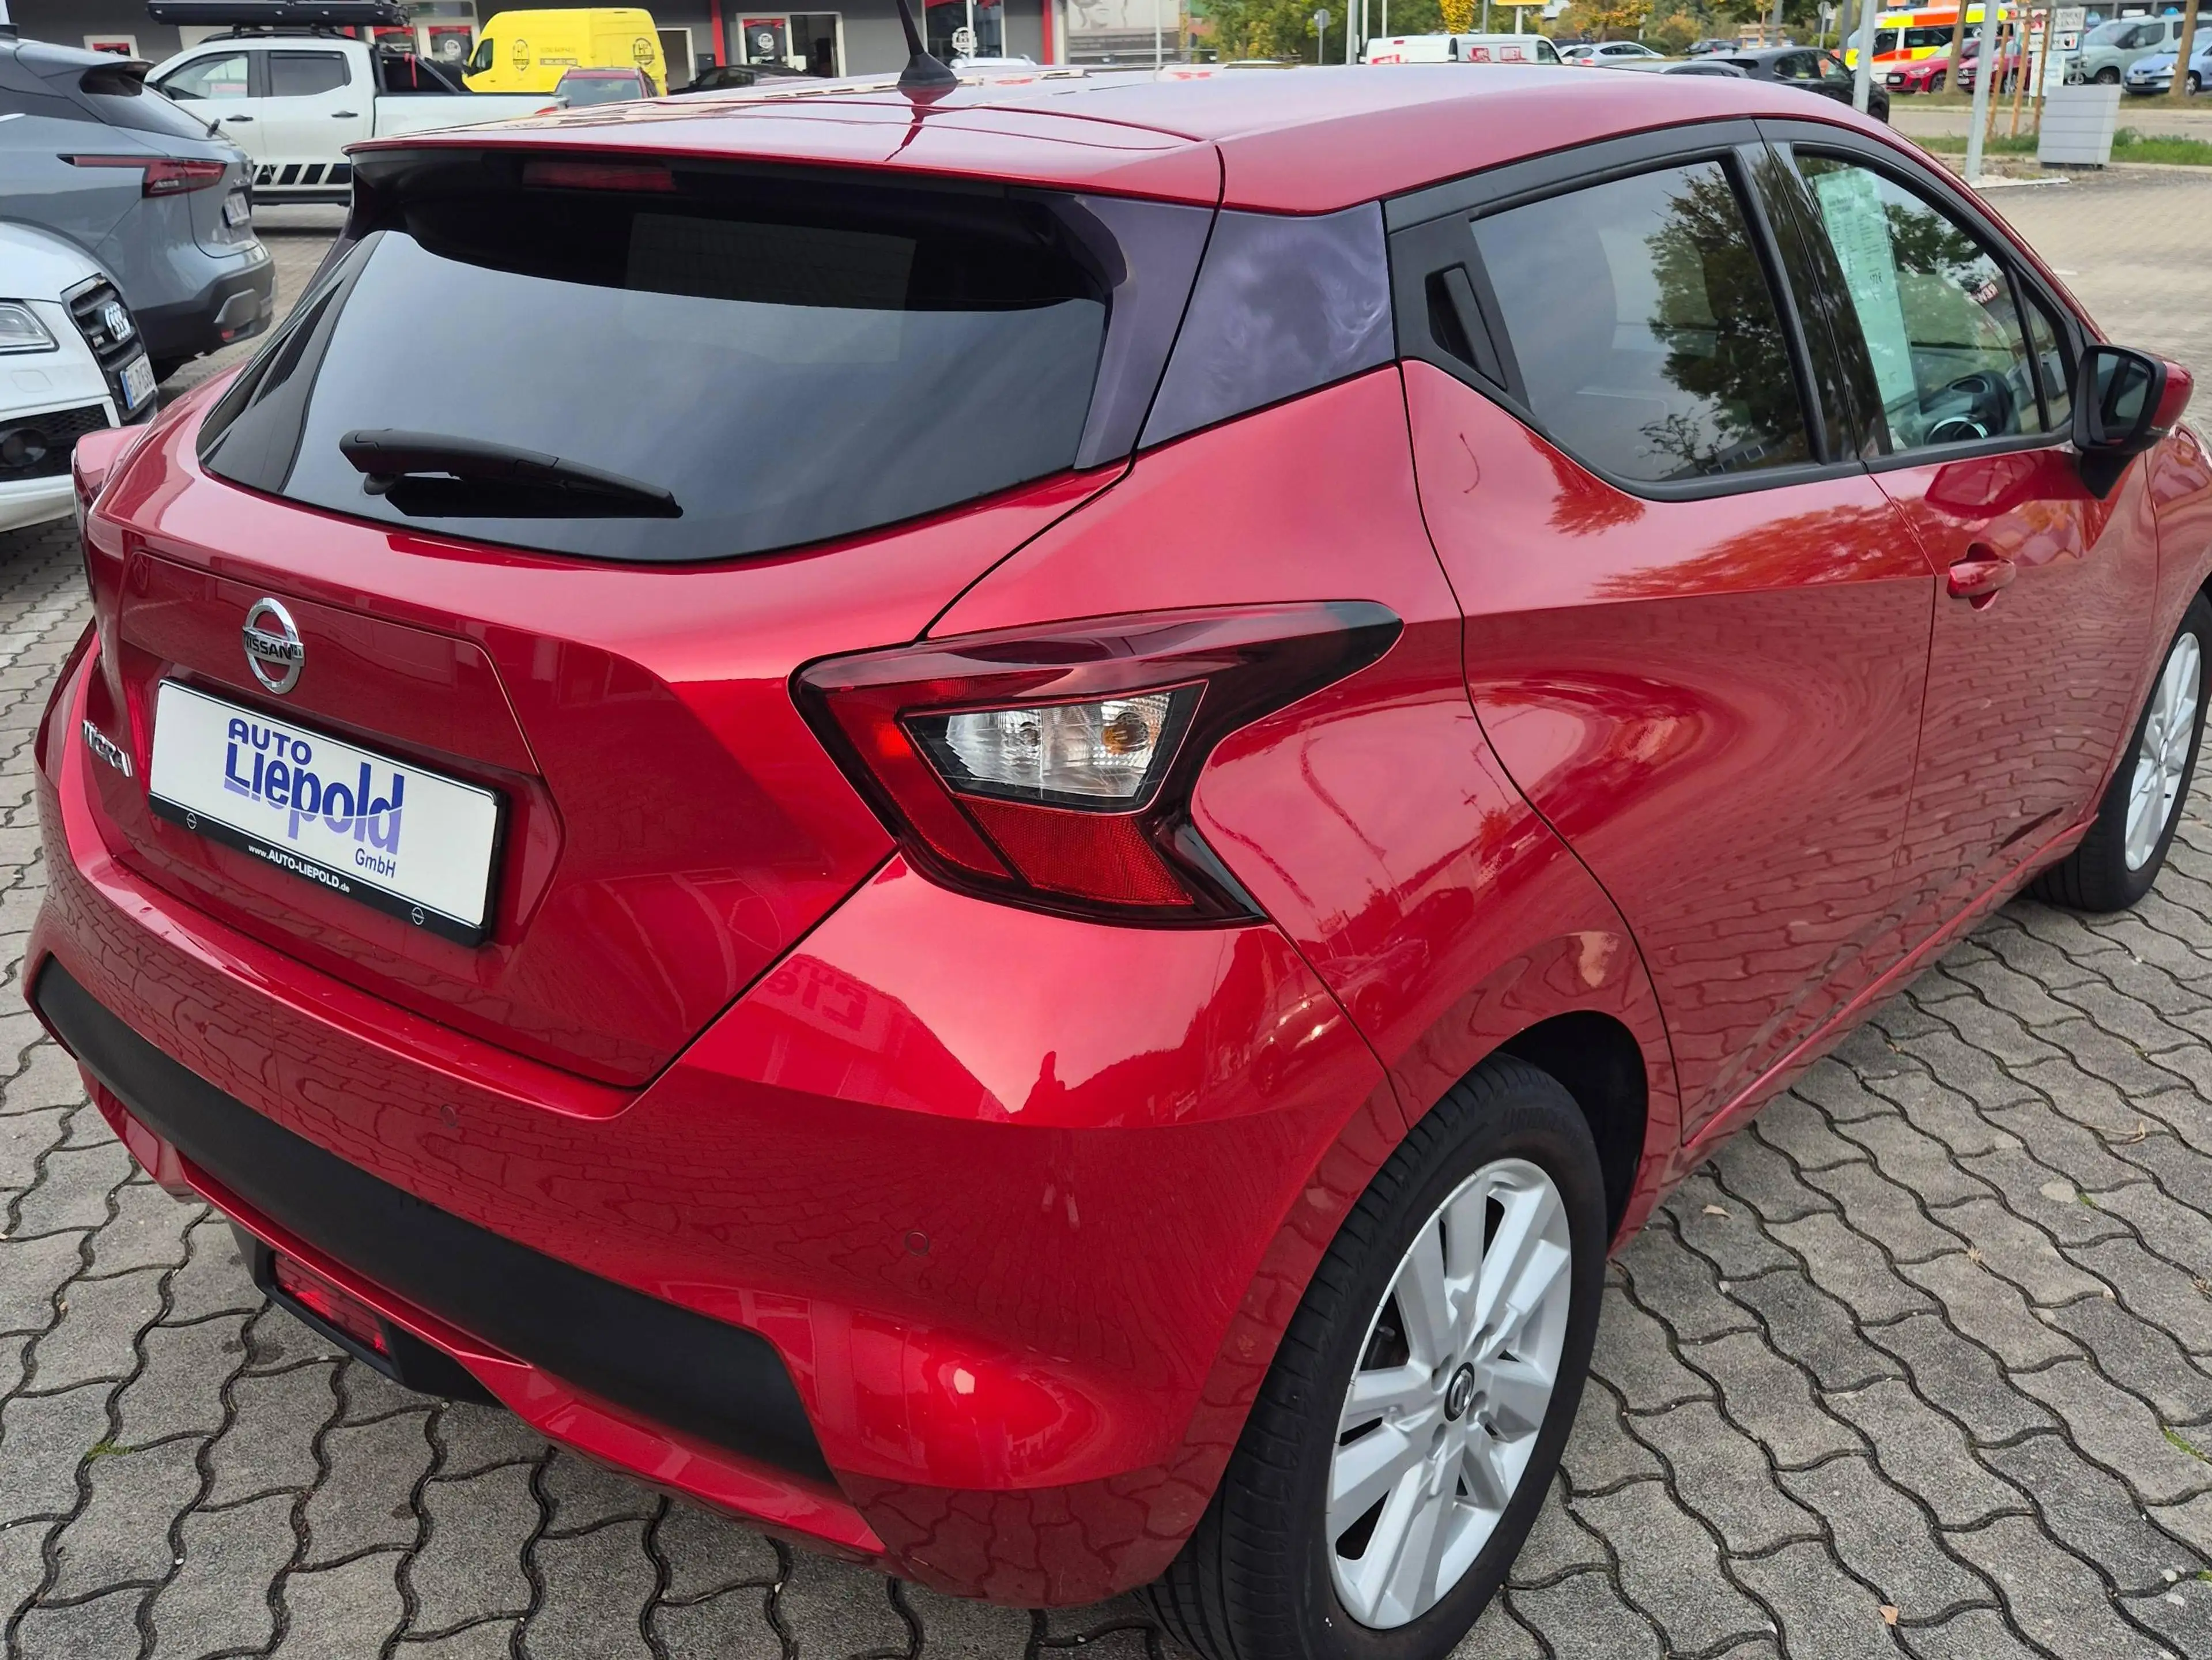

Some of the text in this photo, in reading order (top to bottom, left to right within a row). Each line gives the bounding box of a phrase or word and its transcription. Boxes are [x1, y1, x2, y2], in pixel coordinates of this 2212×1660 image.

[244, 633, 292, 660] NISSAN
[228, 718, 312, 765] AUTO
[248, 845, 350, 893] www.AUTO-LIEPOLD.de
[355, 848, 396, 878] GmbH
